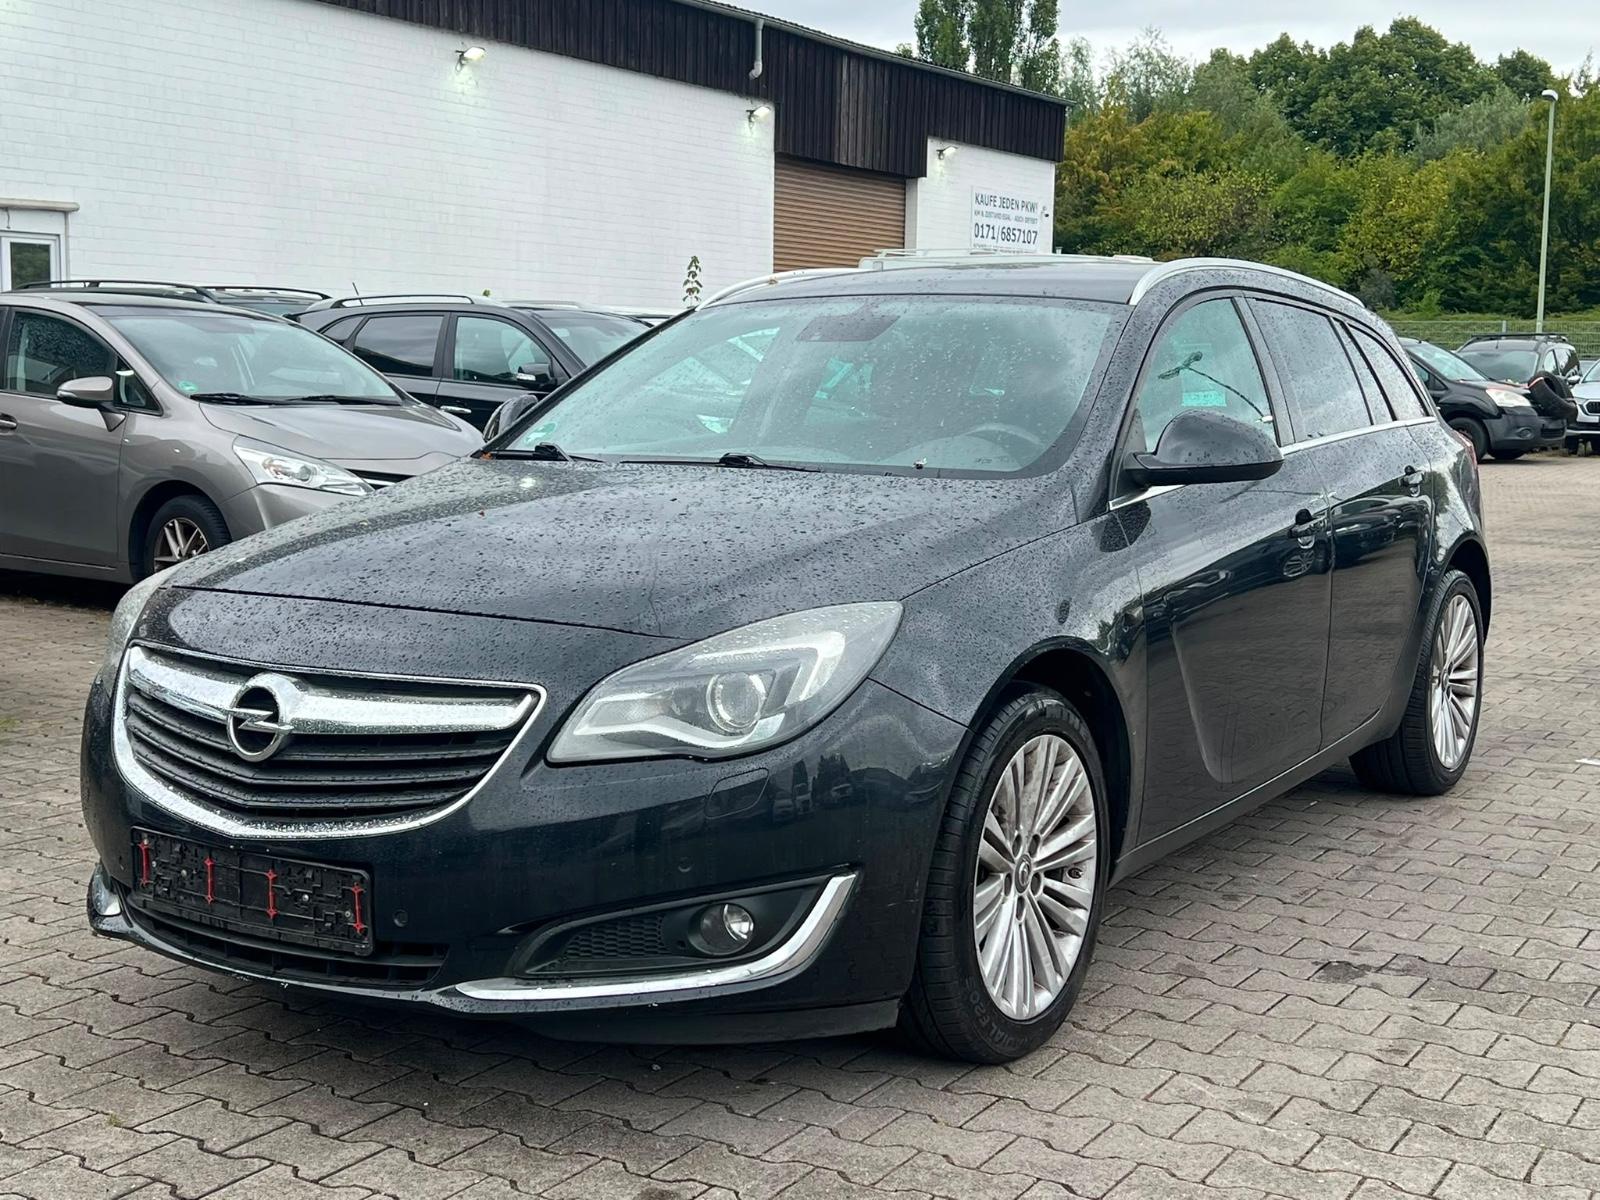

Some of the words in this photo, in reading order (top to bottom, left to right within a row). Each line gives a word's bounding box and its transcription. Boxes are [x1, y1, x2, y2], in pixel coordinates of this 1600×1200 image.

[975, 192, 997, 208] KAUFE
[998, 196, 1020, 211] JEDEN
[974, 222, 1038, 245] 0171/6857107
